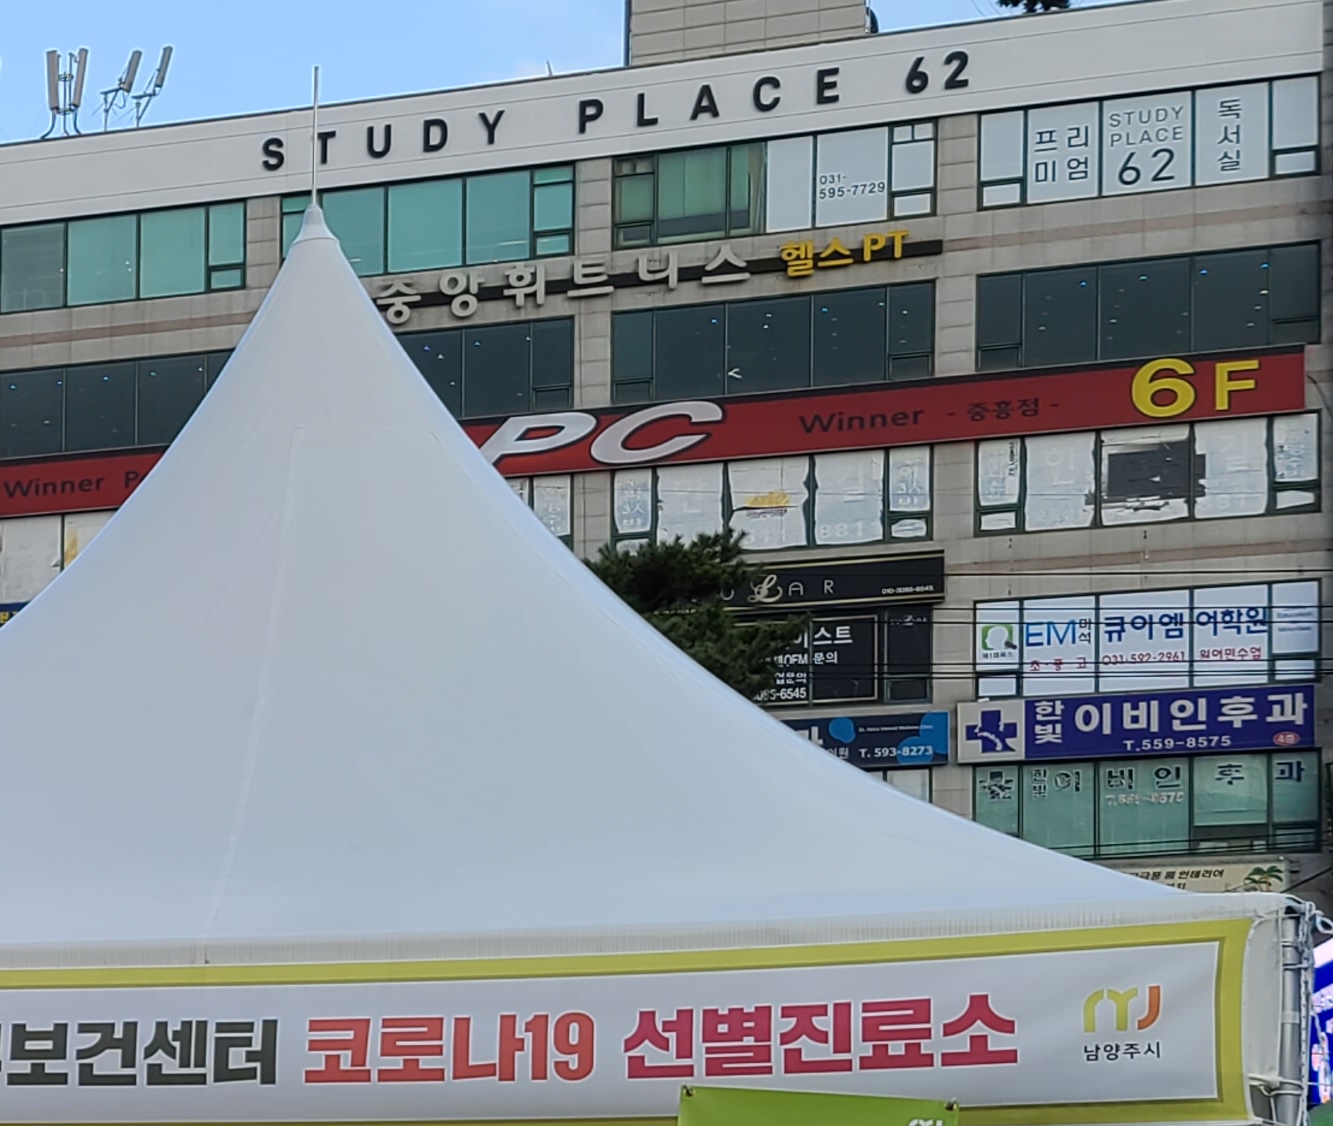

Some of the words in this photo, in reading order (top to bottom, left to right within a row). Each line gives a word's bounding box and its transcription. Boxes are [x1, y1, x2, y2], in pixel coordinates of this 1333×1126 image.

[261, 109, 505, 171] STUDY
[578, 66, 840, 134] PLACE
[904, 50, 970, 94] 62
[1109, 105, 1184, 127] STUDY
[1110, 125, 1184, 147] PLACE
[1118, 148, 1176, 185] 62
[819, 181, 886, 200] 595-7729
[375, 245, 750, 325] 중앙휘트니스
[1131, 358, 1261, 418] 6F
[479, 400, 725, 466] PC
[798, 407, 924, 434] Winner
[4, 475, 106, 498] Winner
[1025, 619, 1077, 647] EM
[1195, 606, 1268, 637] 어학원
[1074, 693, 1308, 735] 이비인후과
[873, 745, 934, 757] 593-8273
[303, 1012, 595, 1085] 코로나19
[622, 993, 1020, 1082] 선별진료소
[1083, 1042, 1163, 1062] 남양주시
